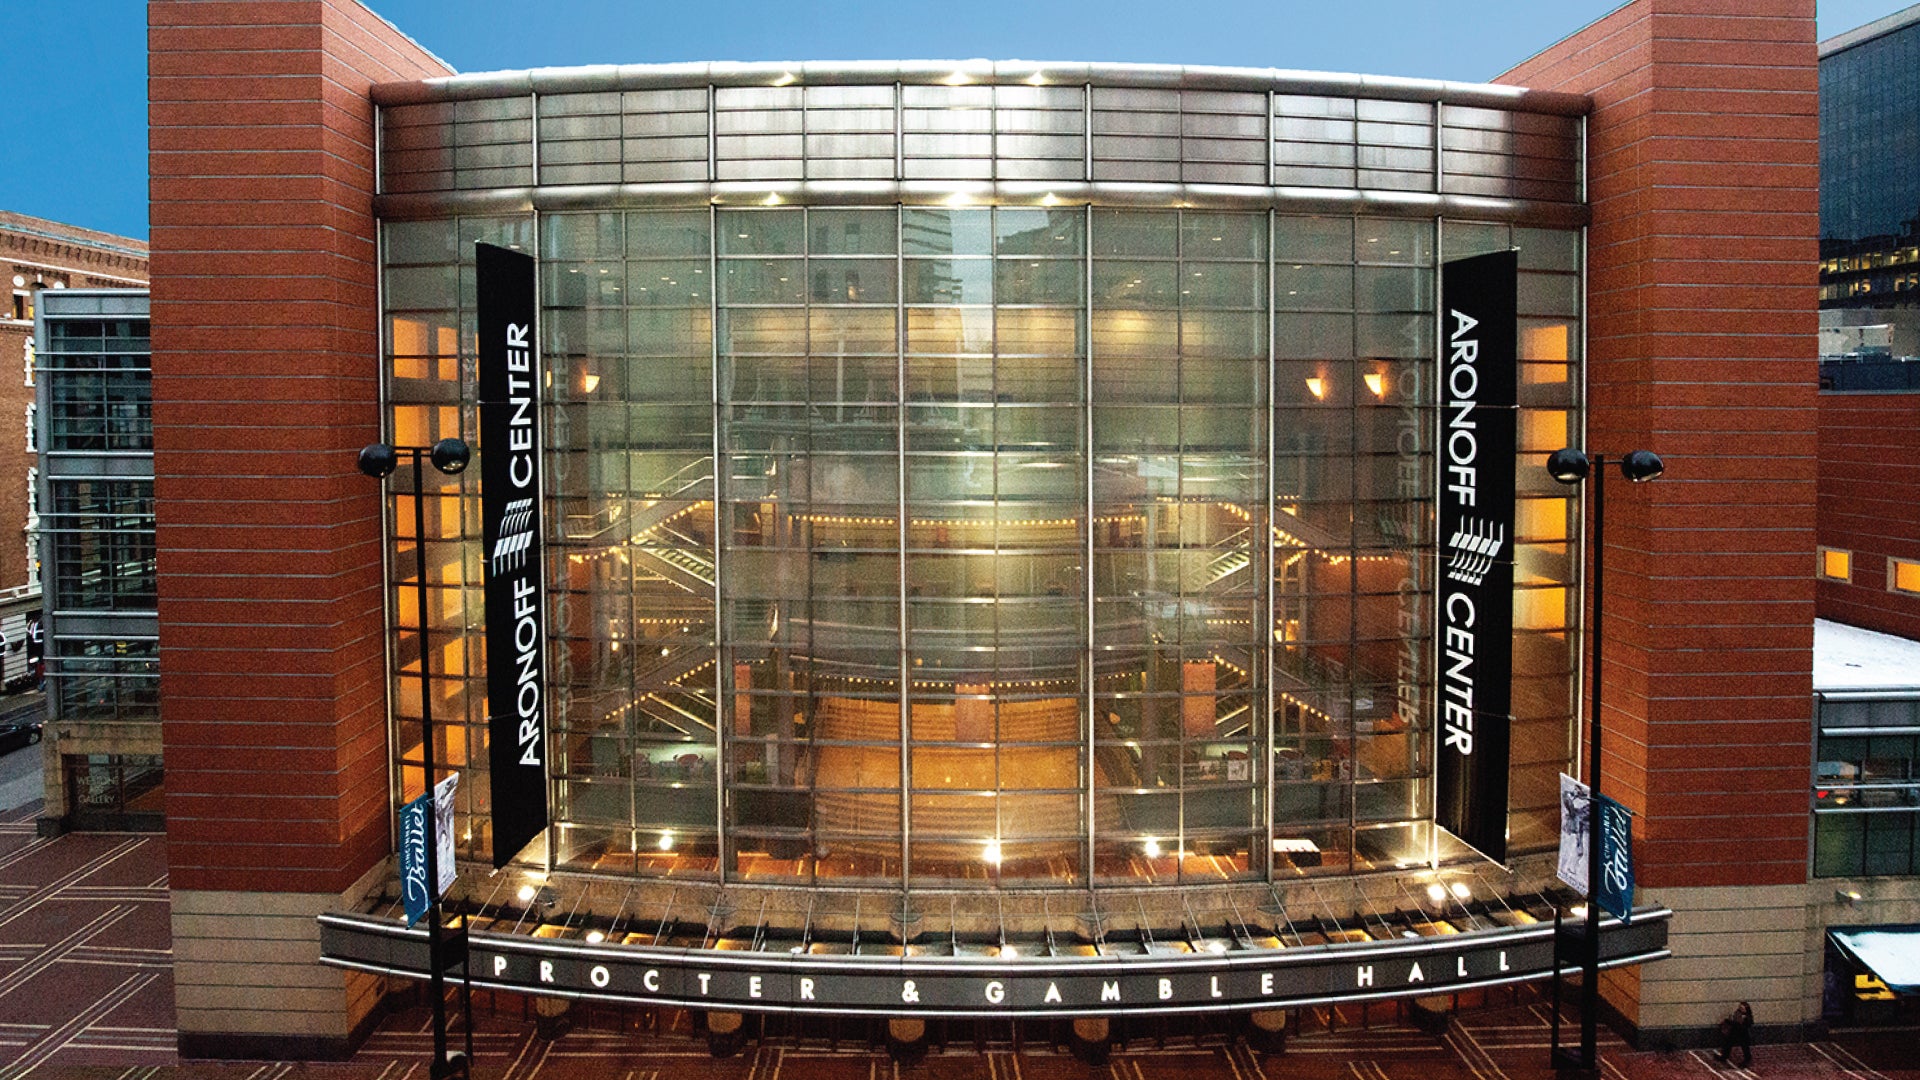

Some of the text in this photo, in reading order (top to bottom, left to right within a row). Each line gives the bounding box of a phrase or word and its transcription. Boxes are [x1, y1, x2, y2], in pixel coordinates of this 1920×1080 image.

[506, 322, 541, 766] ARONOFF CENTER
[1445, 308, 1479, 756] ARONOFF CENTER
[406, 803, 429, 912] Ballet
[1603, 806, 1632, 920] Ballet
[493, 951, 1510, 1004] PROCTER & GAMBLE HALL
